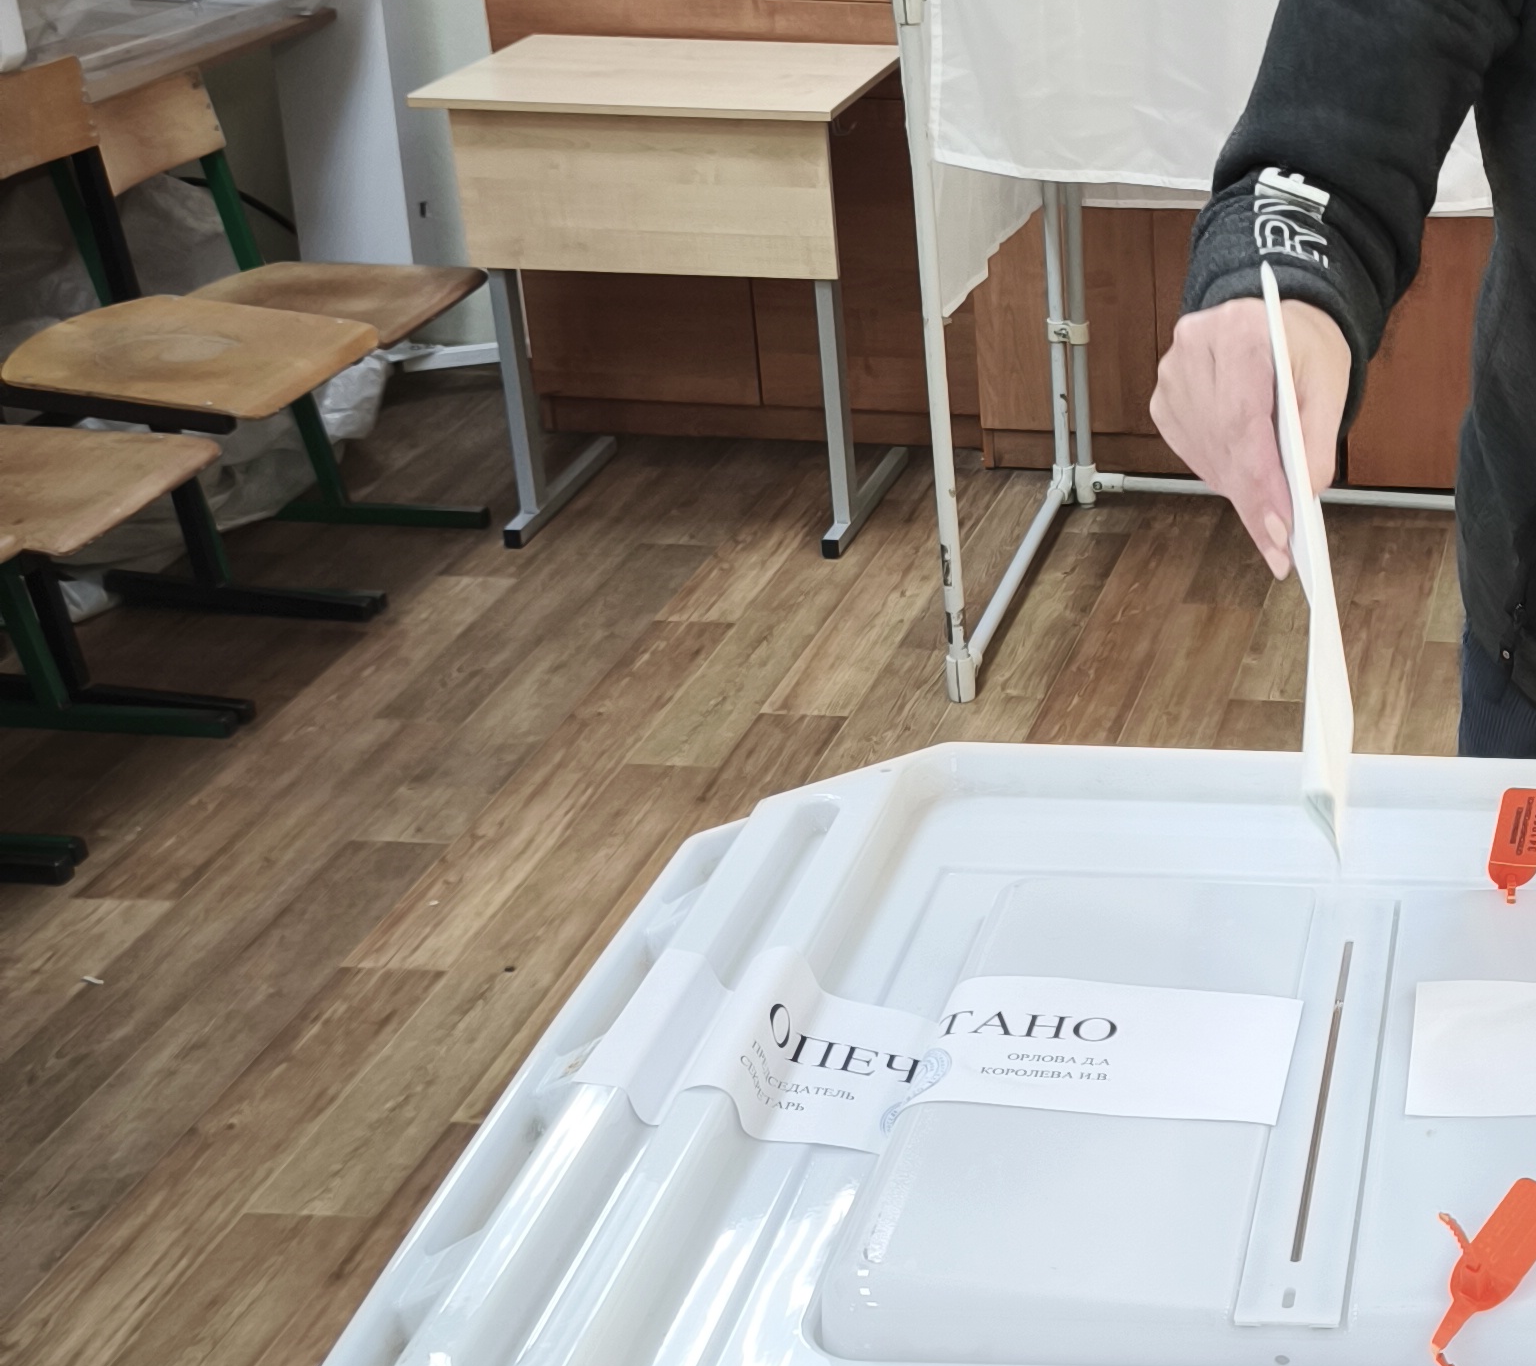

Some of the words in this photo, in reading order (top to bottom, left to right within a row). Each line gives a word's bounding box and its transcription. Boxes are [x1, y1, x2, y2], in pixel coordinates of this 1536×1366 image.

[740, 1054, 805, 1112] СЕКРЕТАРЬ
[980, 1066, 1074, 1080] КОРОЛЕВА
[751, 1040, 855, 1101] ПРЕДСЕДАТЕЛЬ
[1007, 1052, 1077, 1066] ОРЛОВА
